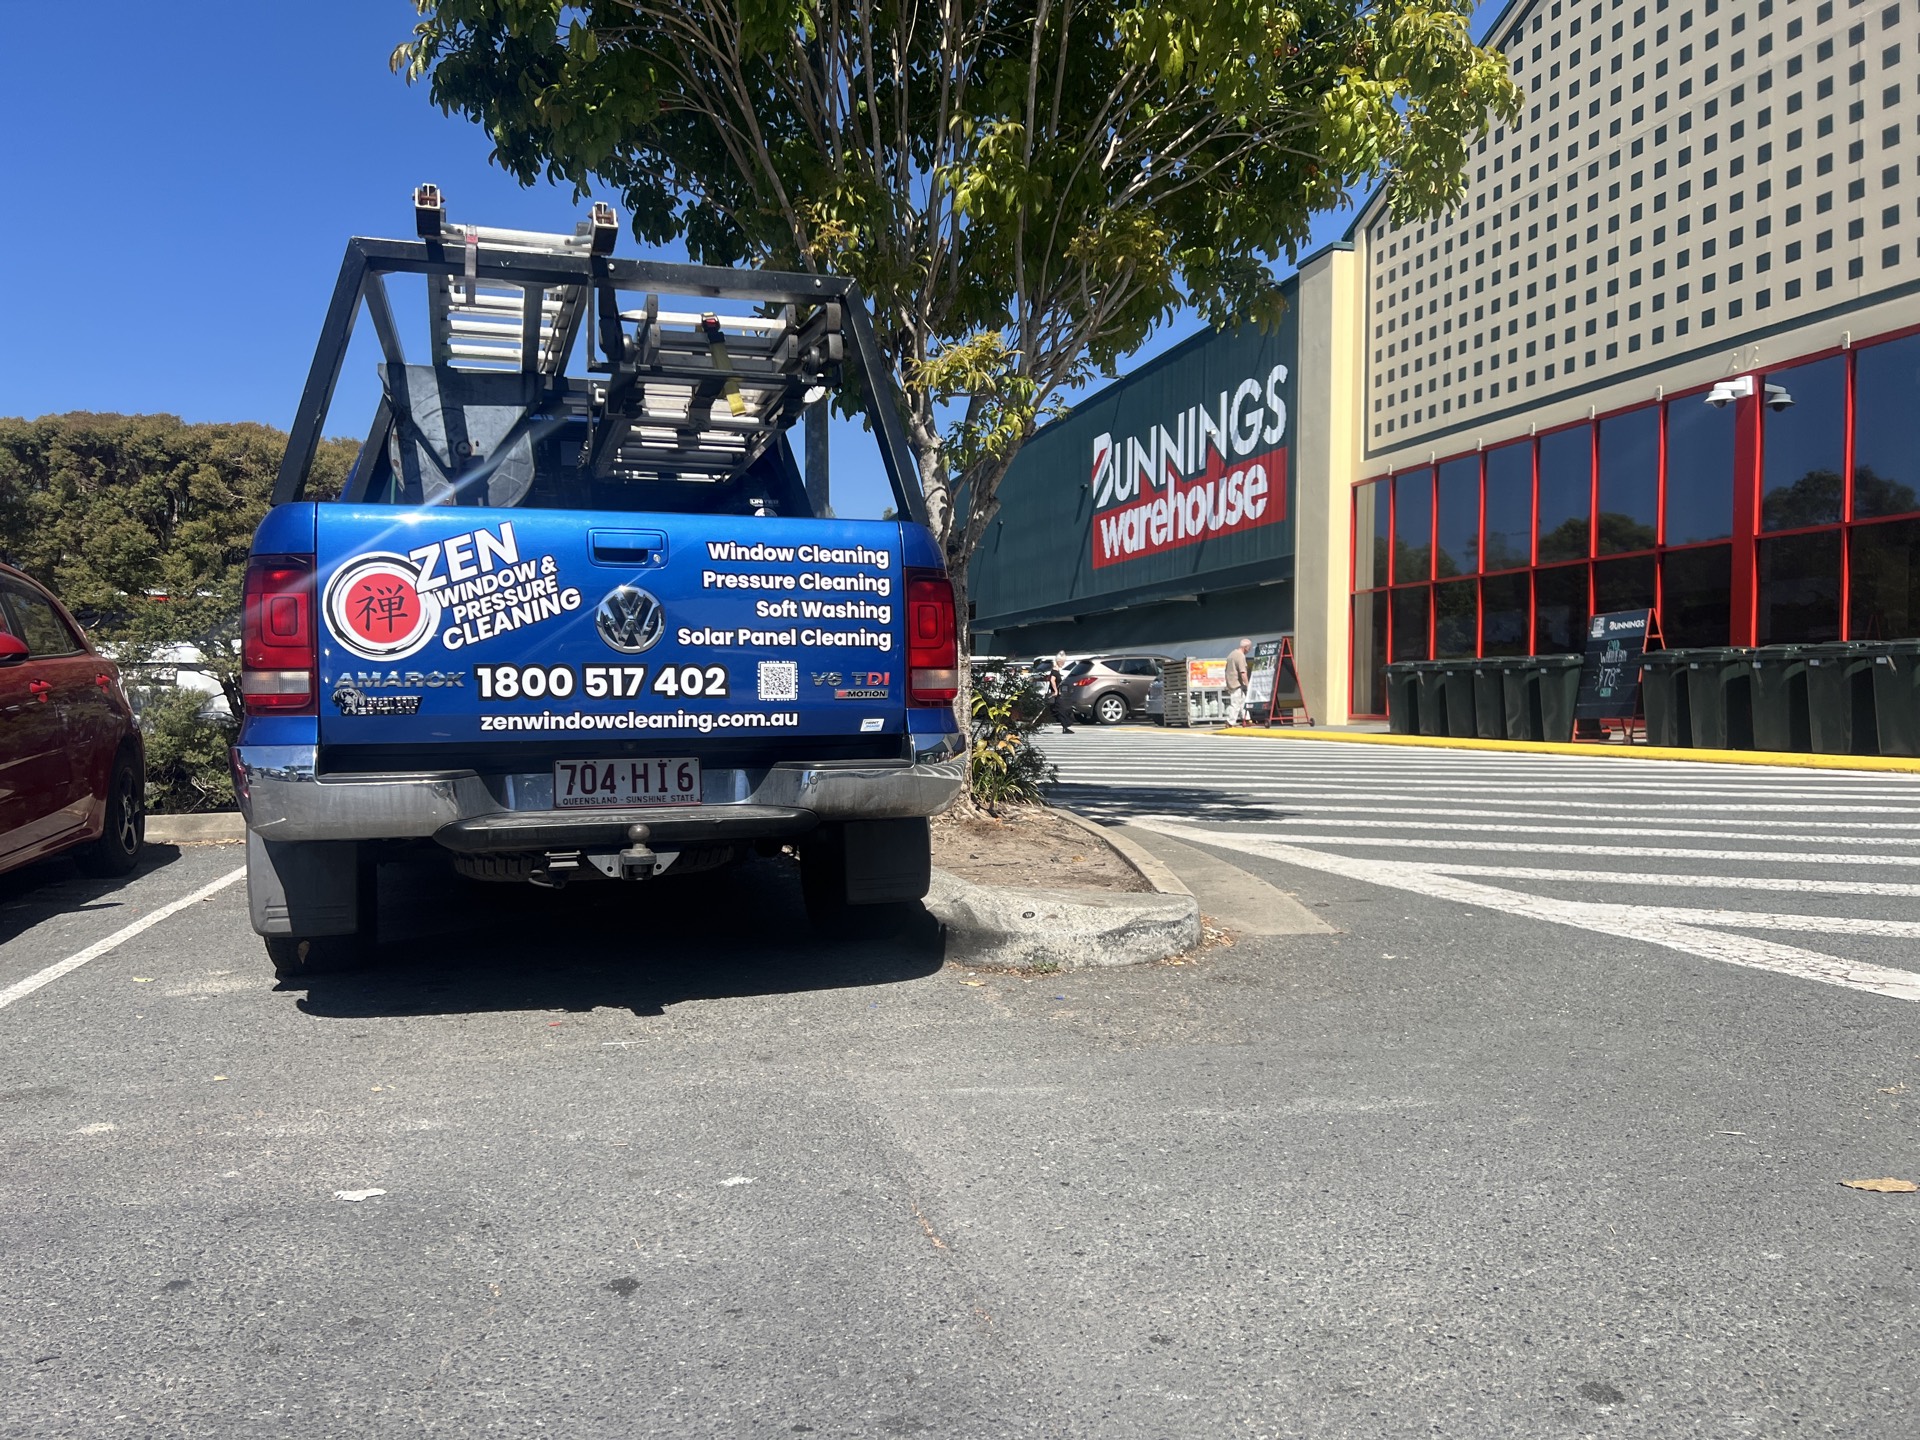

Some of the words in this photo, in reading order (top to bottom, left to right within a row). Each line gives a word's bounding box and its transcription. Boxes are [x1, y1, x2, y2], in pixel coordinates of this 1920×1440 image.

[1093, 364, 1288, 508] BUNNINGS
[1100, 464, 1268, 559] warehouse
[409, 521, 519, 594] ZEN
[707, 542, 795, 562] Window
[797, 546, 890, 569] Cleaning
[435, 560, 537, 608] WINDOW
[540, 555, 558, 575] &
[703, 571, 795, 590] Pressure
[799, 573, 891, 597] Cleaning
[452, 575, 558, 625] PRESSURE
[756, 600, 798, 618] Soft
[801, 601, 891, 624] Washing
[442, 588, 582, 650] CLEANING
[1609, 619, 1645, 631] BUNNINGS
[677, 628, 734, 645] Solar
[738, 628, 796, 646] Panel
[800, 629, 892, 652] Cleaning
[333, 671, 466, 688] AMAROK
[477, 667, 573, 697] 1800
[585, 667, 645, 697] 517
[653, 666, 727, 696] 402
[810, 671, 843, 686] V6
[851, 671, 890, 686] TDI
[481, 710, 798, 733] zenwindowcleaning.com.au
[562, 796, 618, 806] QUEENSLAND
[626, 795, 667, 804] SUNSHINE
[670, 794, 695, 803] STATE
